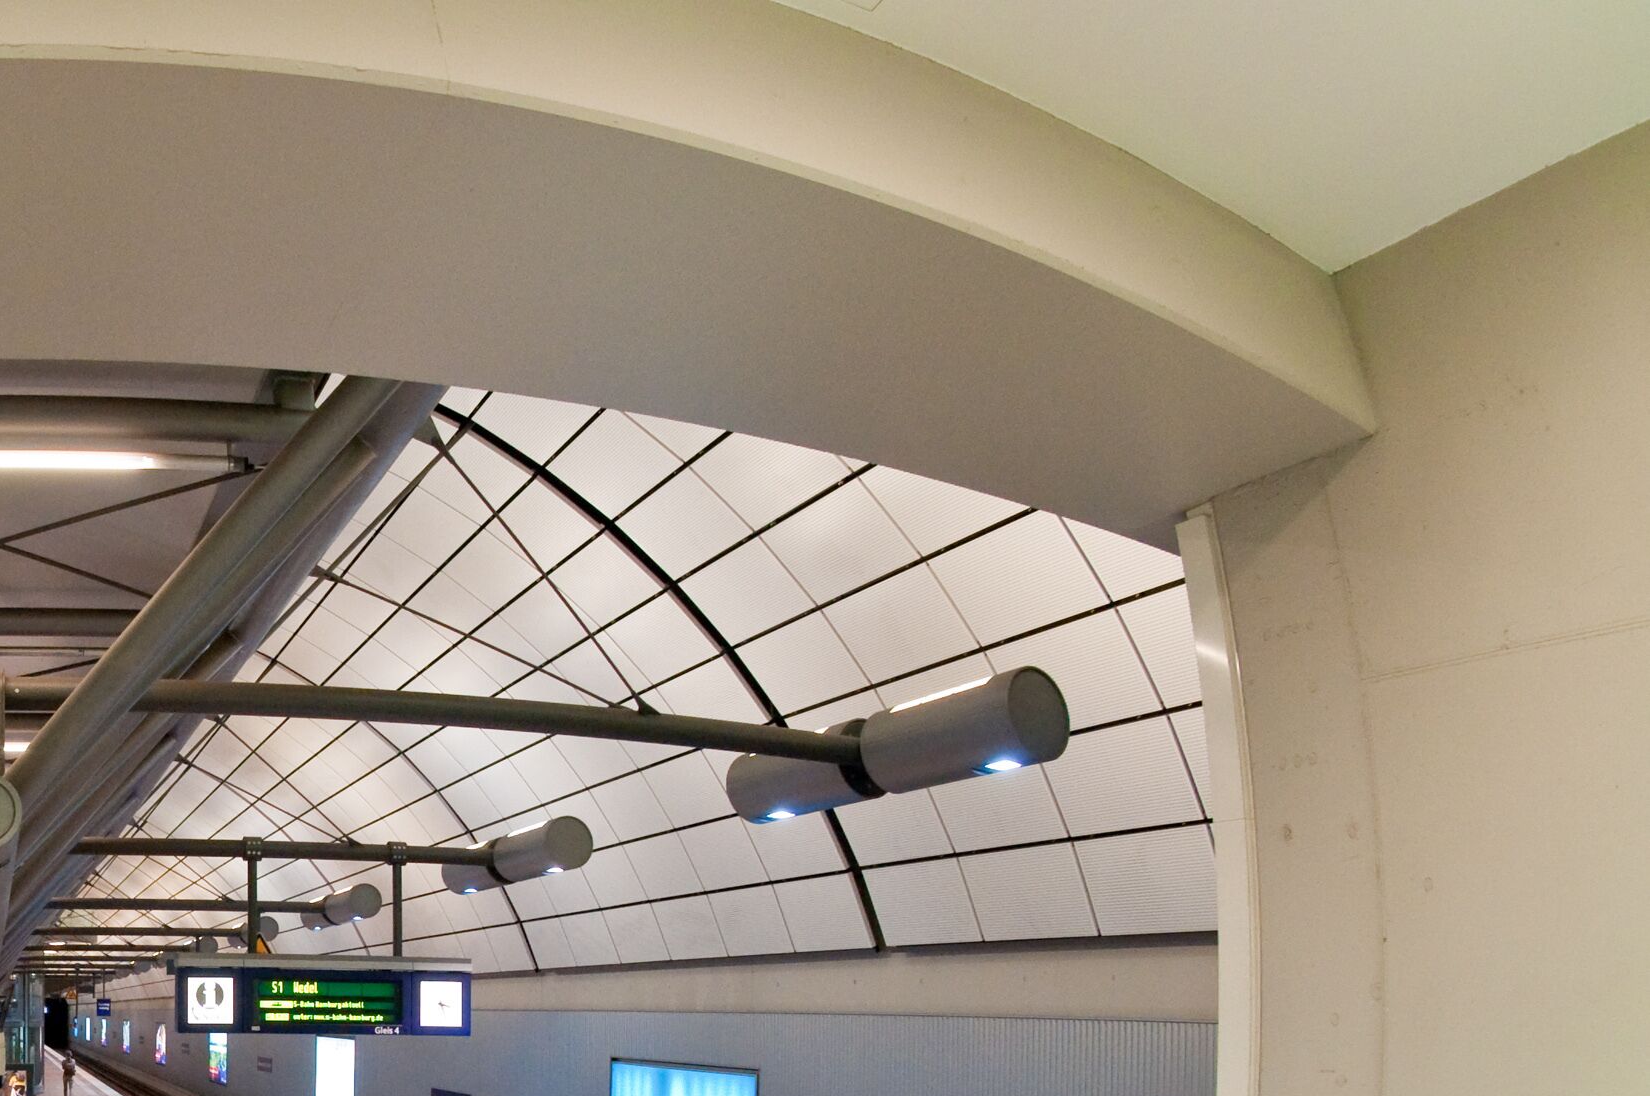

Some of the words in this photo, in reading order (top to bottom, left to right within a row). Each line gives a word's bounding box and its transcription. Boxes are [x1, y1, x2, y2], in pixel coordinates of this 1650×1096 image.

[271, 981, 284, 994] S1
[374, 1026, 393, 1034] Gleis
[394, 1026, 400, 1034] 4
